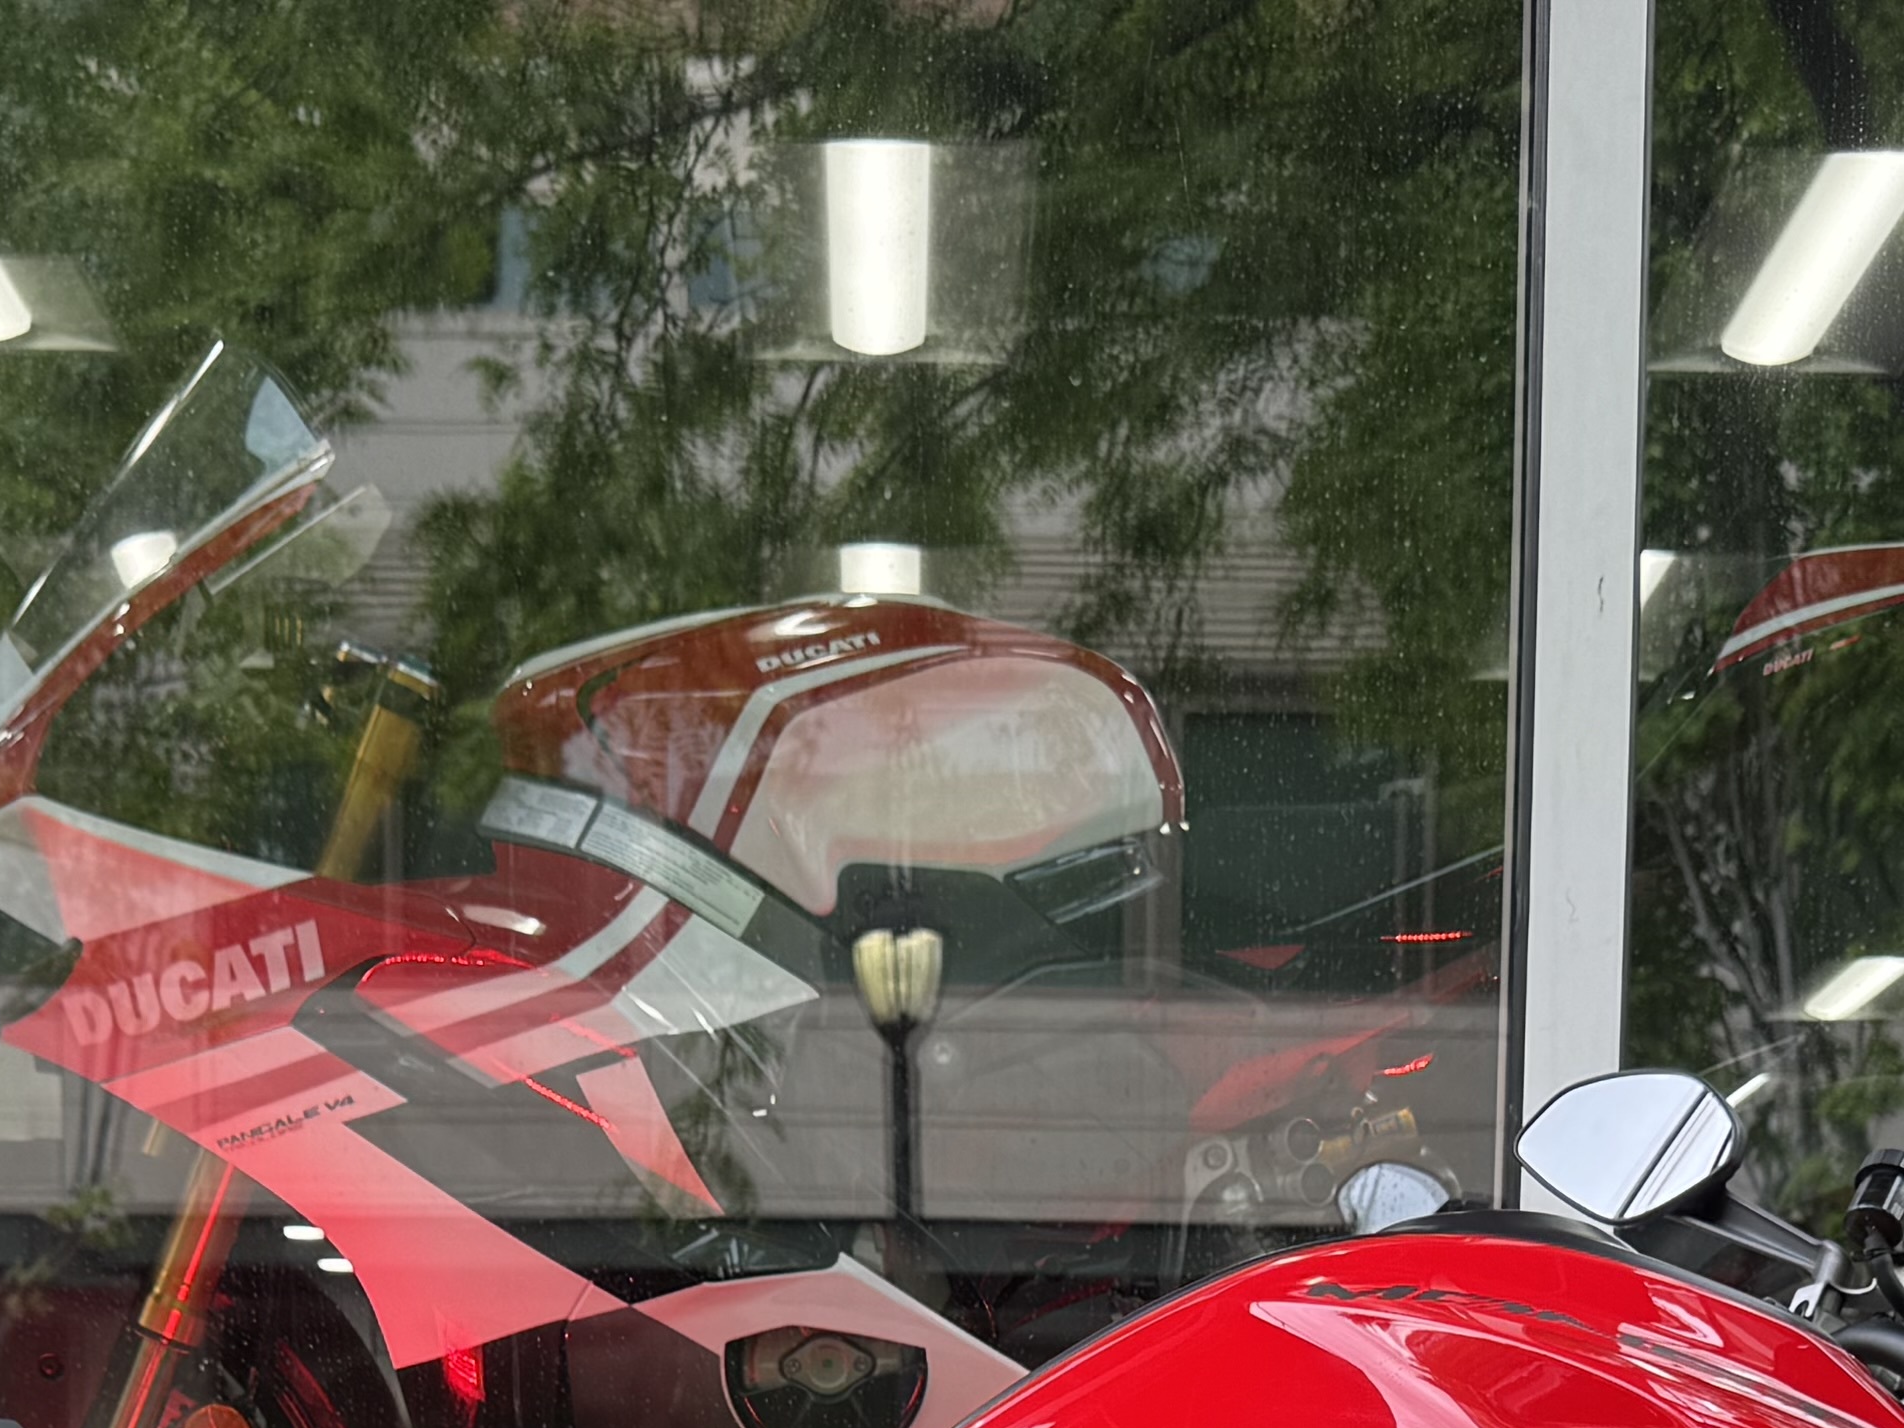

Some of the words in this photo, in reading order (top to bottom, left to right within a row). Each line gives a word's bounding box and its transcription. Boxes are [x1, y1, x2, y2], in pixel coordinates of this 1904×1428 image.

[756, 632, 881, 673] DUCATI
[62, 919, 326, 1047] DUCATI
[323, 1094, 355, 1112] V4
